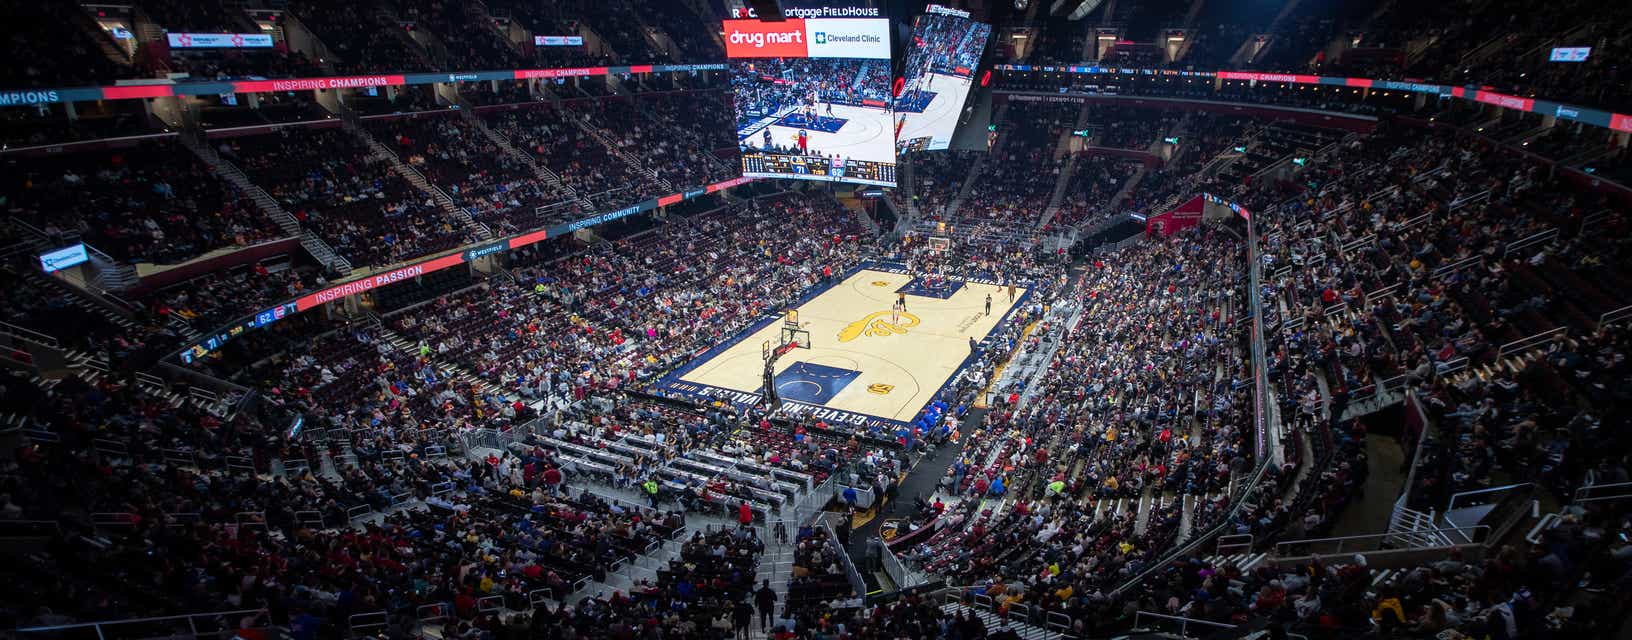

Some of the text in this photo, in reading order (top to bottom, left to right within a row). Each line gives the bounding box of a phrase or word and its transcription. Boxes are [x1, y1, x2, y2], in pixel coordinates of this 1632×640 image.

[732, 8, 758, 18] ROC
[785, 8, 822, 18] ortgage
[730, 30, 802, 47] drug mart
[827, 34, 881, 43] Cleveland Clinic
[556, 69, 590, 77] CHAMPIONS
[273, 76, 388, 91] INSPIRING CHAMPIONS
[0, 90, 59, 105] MPIONS
[797, 166, 805, 174] 71
[832, 169, 842, 177] 62
[603, 205, 641, 222] COMMUNITY
[477, 245, 503, 256] WESTFIELD
[315, 265, 423, 304] INSPIRING PASSION
[207, 338, 218, 350] 71
[260, 313, 271, 325] 62
